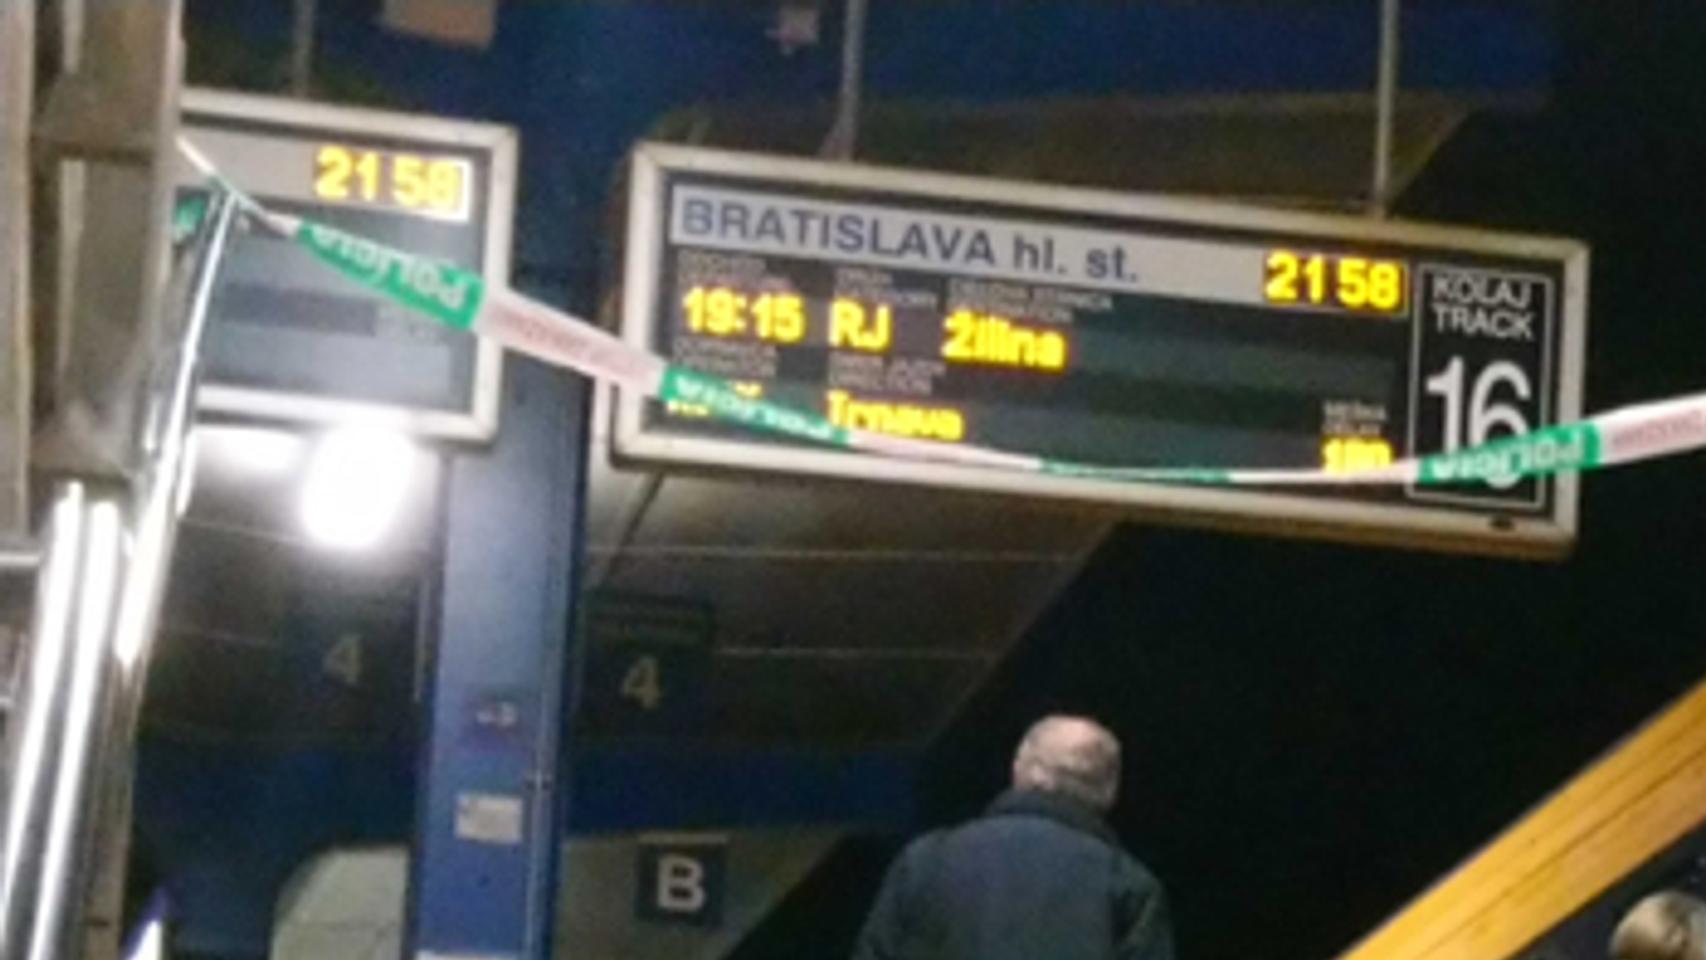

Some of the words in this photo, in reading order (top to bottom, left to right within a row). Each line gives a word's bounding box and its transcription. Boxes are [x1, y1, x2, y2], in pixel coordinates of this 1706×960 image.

[314, 145, 381, 200] 21
[681, 198, 996, 265] BRATISLAVA
[1012, 234, 1068, 275] hl.
[1085, 244, 1139, 283] st.
[1265, 250, 1326, 303] 21
[1337, 257, 1401, 309] 58
[684, 288, 805, 343] 19:15
[829, 298, 891, 350] RJ
[1431, 303, 1536, 342] TRACK
[828, 389, 964, 441] Trnava
[1426, 356, 1532, 490] 16
[321, 633, 363, 684] 4
[620, 655, 663, 709] 4
[657, 853, 707, 912] B
